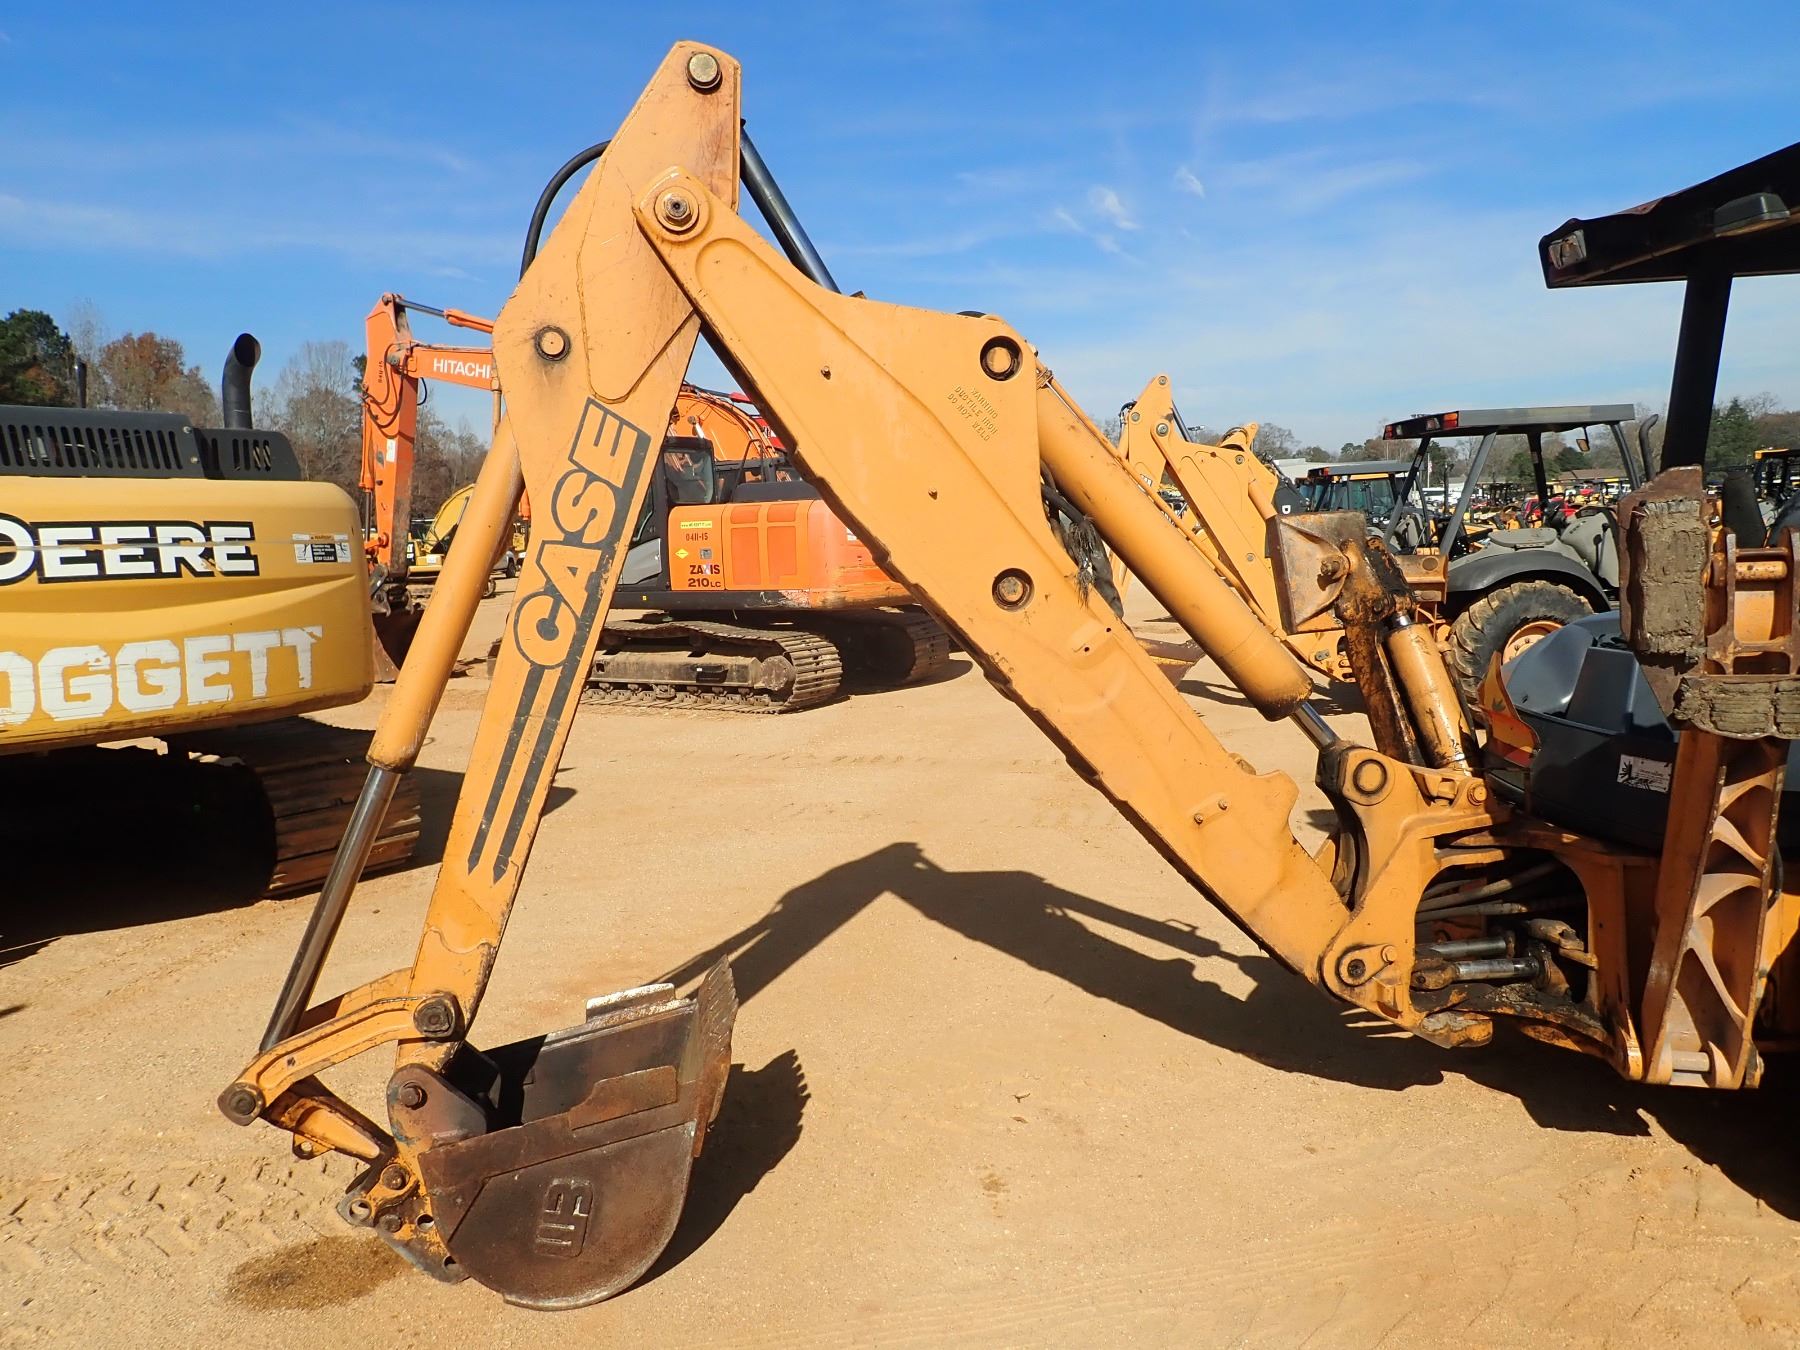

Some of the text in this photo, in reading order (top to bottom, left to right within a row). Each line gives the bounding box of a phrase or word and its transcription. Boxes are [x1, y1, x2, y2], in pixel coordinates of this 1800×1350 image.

[433, 357, 491, 379] HITACHI
[514, 397, 652, 670] CASE
[685, 532, 709, 541] 0411-15
